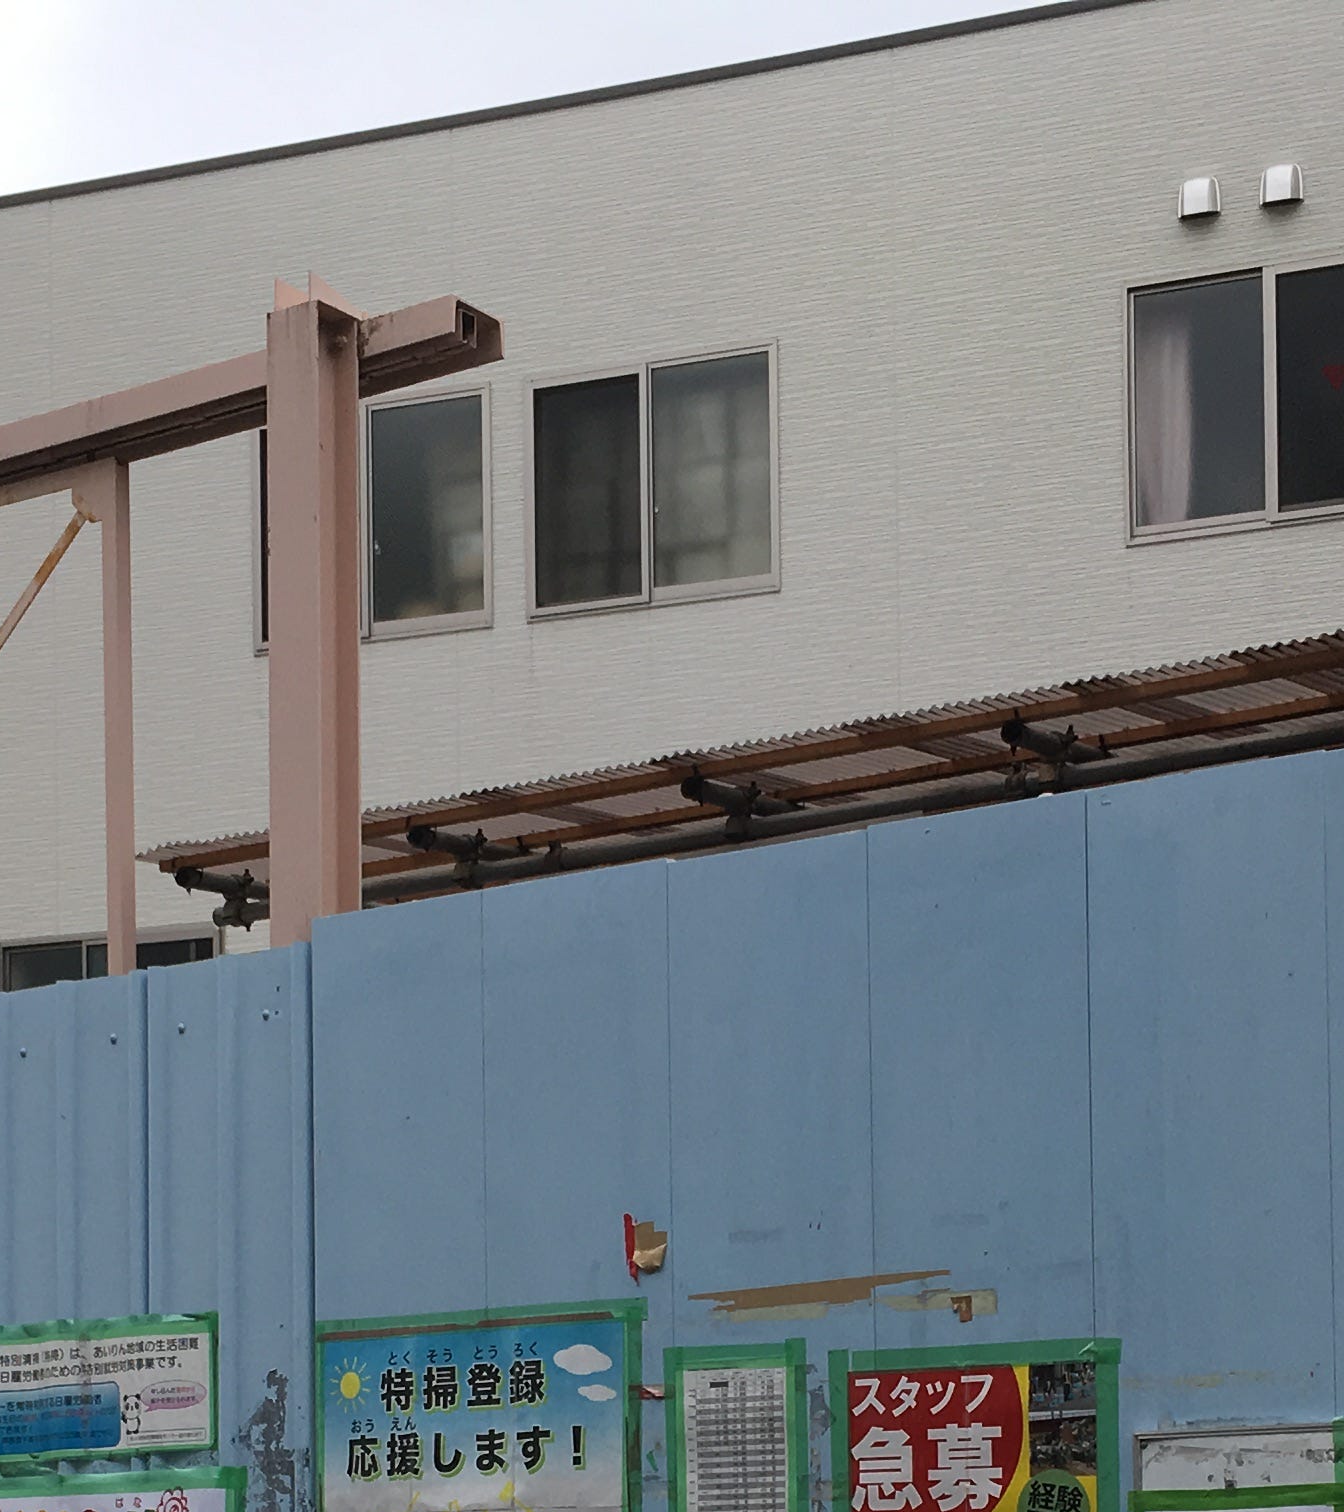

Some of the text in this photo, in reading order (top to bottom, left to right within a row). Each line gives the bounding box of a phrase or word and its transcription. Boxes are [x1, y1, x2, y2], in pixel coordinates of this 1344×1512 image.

[388, 1342, 538, 1365] とく そう とう ろく
[380, 1359, 545, 1412] 特掃登録
[852, 1374, 994, 1418] スタッフ
[350, 1416, 417, 1433] おう えん
[346, 1425, 584, 1478] 応援します！
[851, 1422, 1003, 1512] 急募
